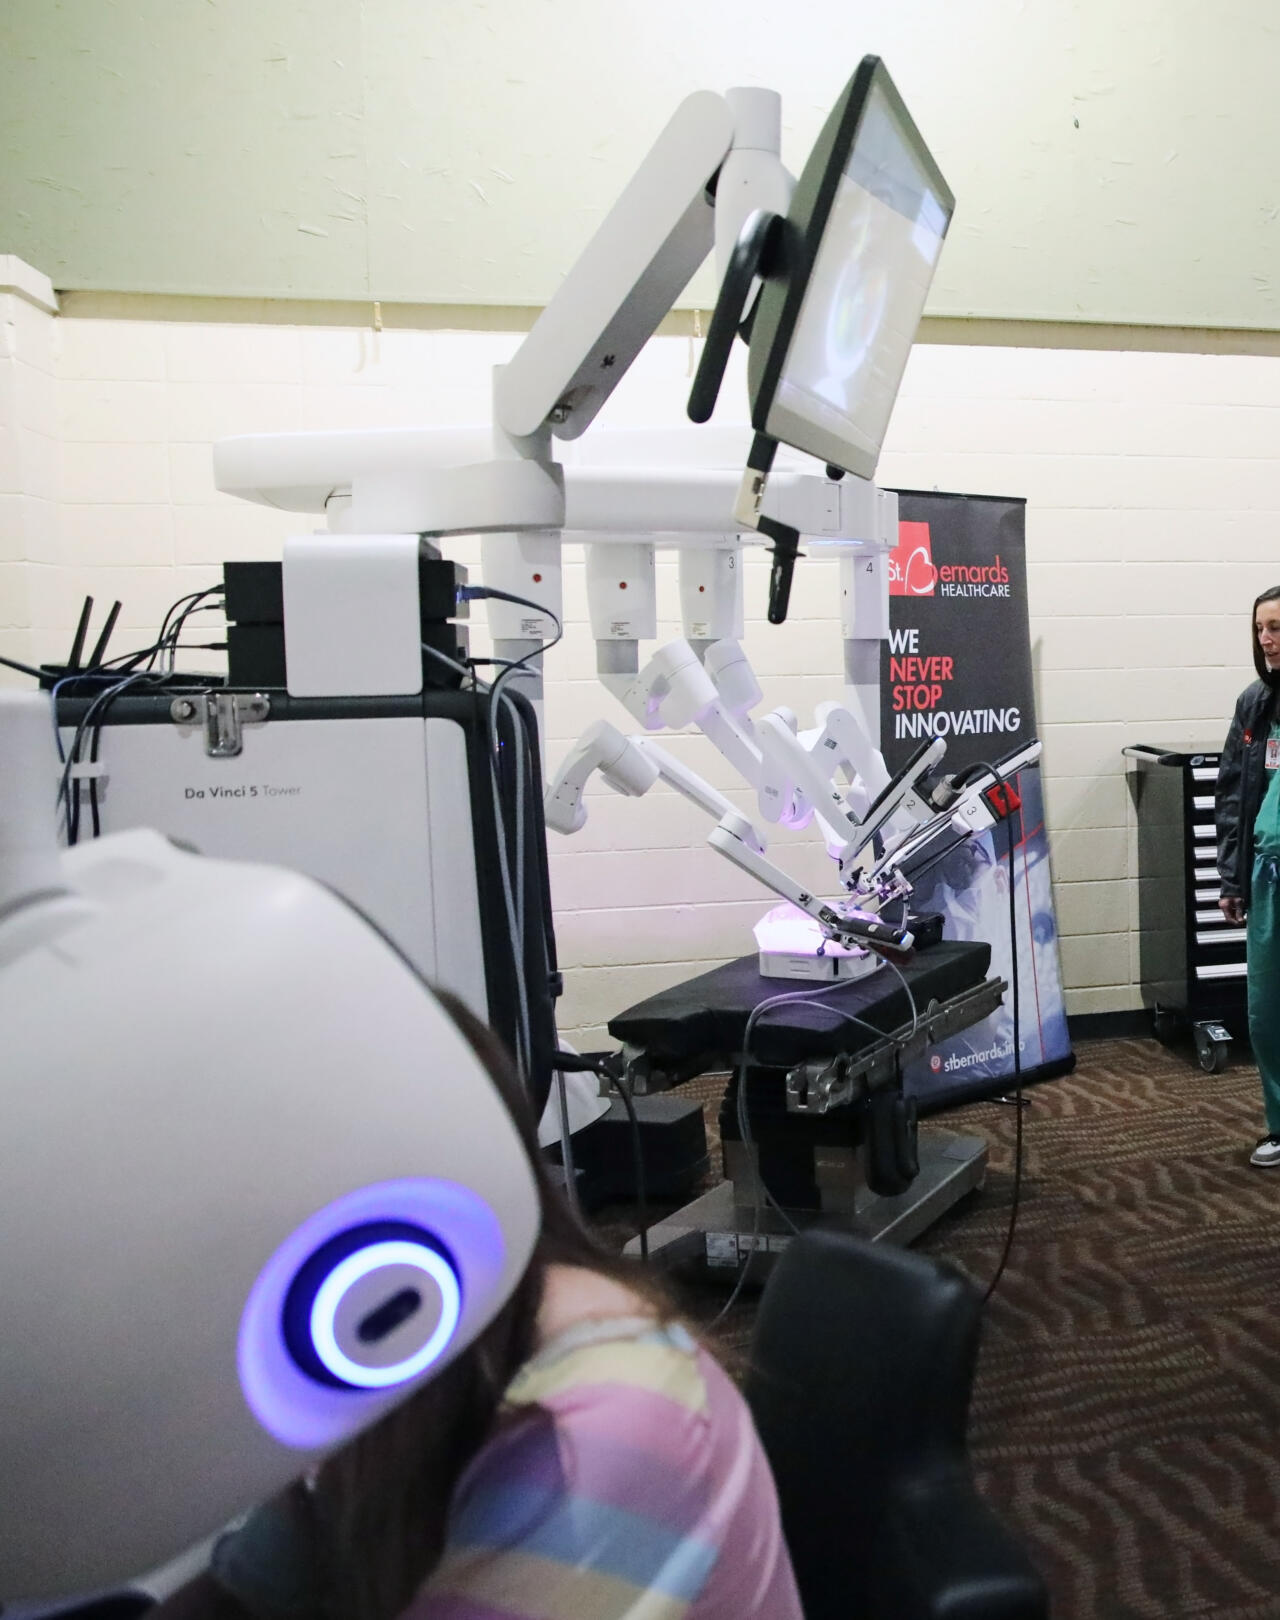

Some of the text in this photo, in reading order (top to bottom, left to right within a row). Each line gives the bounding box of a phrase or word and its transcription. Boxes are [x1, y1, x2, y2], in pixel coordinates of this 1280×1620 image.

[728, 556, 735, 569] 3
[866, 562, 873, 573] 4
[941, 583, 1011, 597] HEALTHCARE
[888, 629, 919, 654] WE
[890, 656, 954, 682] NEVER
[892, 685, 943, 711] STOP
[895, 707, 1021, 739] INNOVATING
[185, 784, 301, 799] Da Vinci 5 Tower
[944, 1040, 1026, 1073] stbernards.ino
